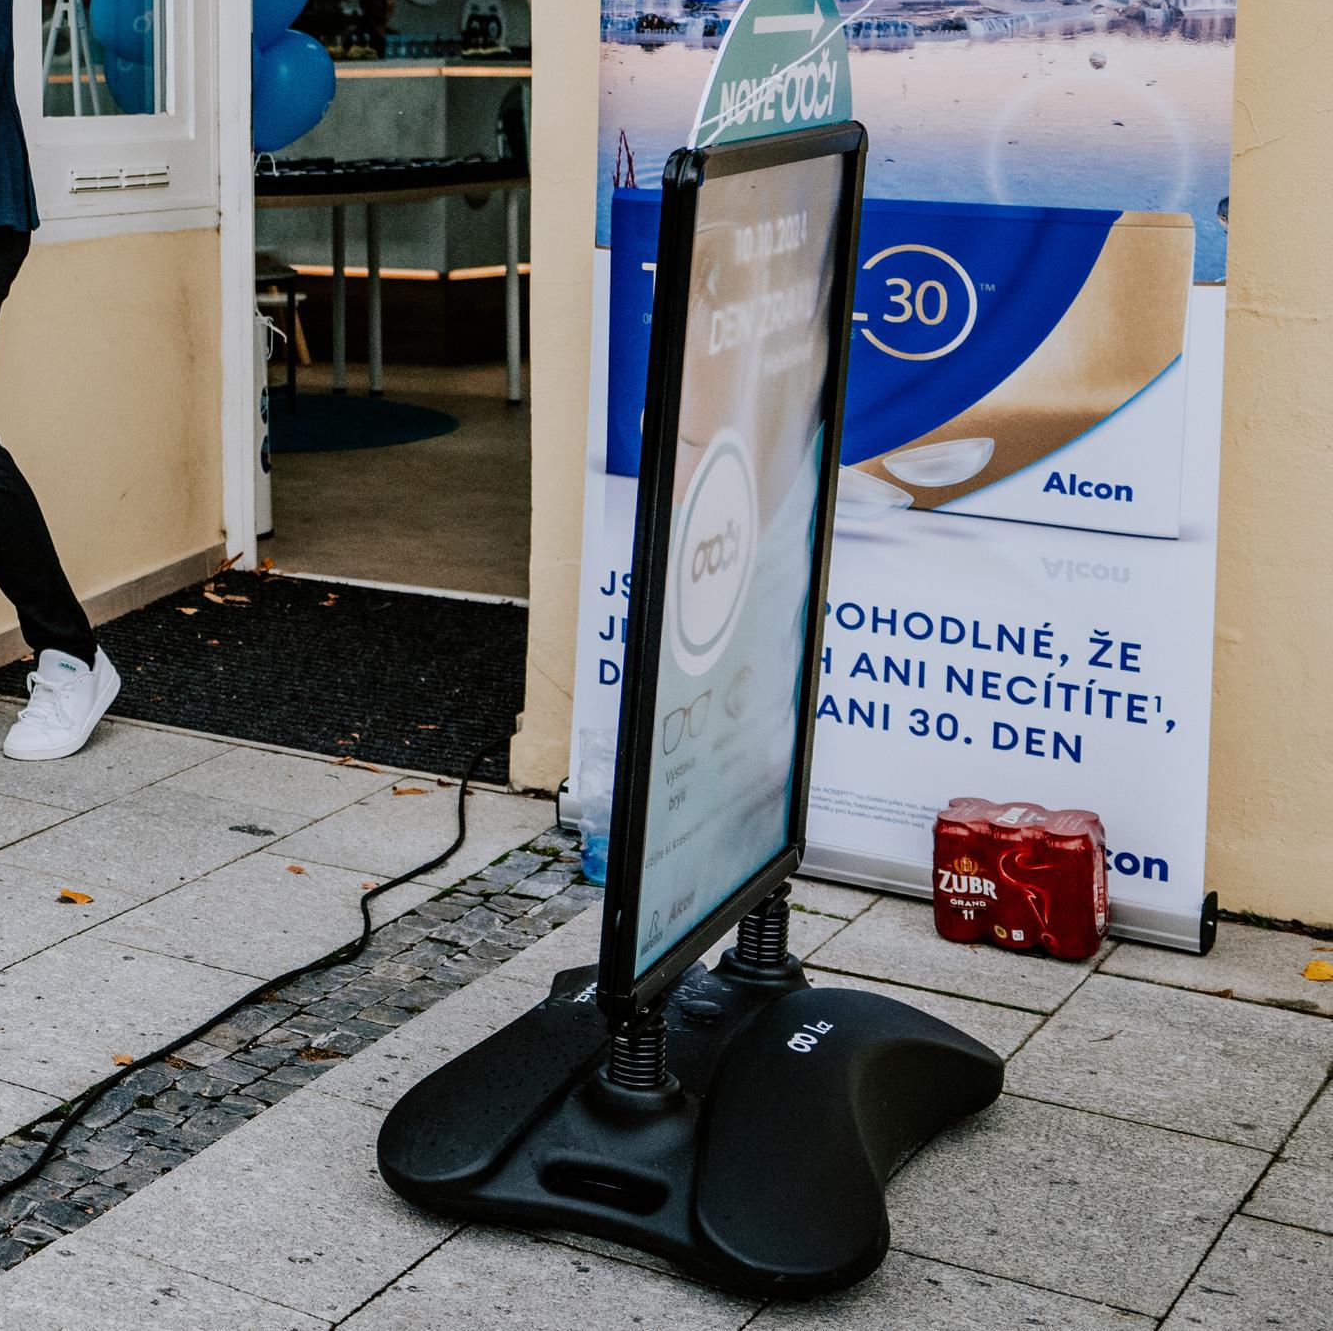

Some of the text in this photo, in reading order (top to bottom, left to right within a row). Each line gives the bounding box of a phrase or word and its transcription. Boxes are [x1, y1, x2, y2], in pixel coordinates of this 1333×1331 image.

[883, 277, 948, 326] 30
[1042, 471, 1133, 502] Alcon
[1088, 629, 1141, 673] ŽE
[849, 652, 926, 689] ANI
[816, 694, 1082, 764] ANI 30. DEN
[937, 868, 998, 901] ZUBR
[950, 898, 987, 908] GRAND
[962, 909, 975, 921] 11
